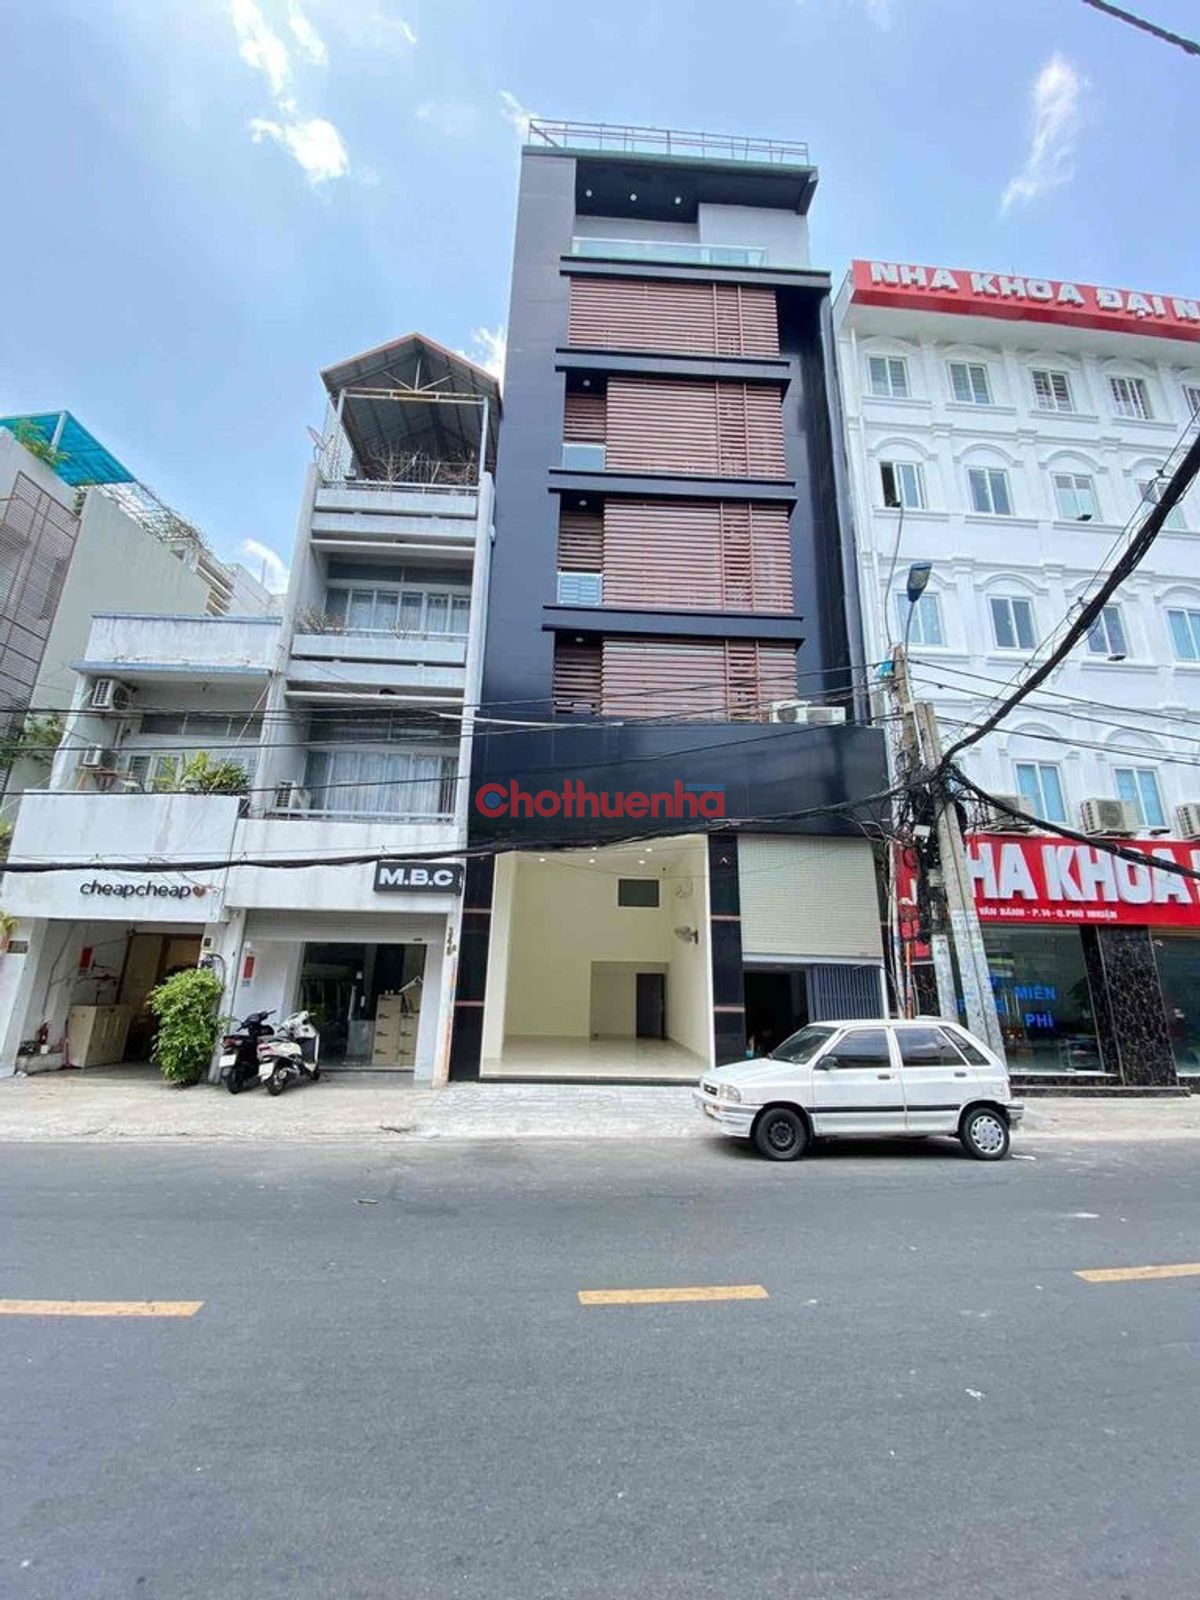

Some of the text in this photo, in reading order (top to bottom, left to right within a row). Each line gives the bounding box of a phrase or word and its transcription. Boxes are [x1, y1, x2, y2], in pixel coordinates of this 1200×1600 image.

[871, 261, 960, 291] NHA
[970, 272, 1084, 306] KHOA
[1096, 287, 1163, 317] ĐẠI
[80, 880, 191, 899] cheapcheap
[379, 867, 455, 886] M.B.C
[965, 842, 1037, 900] HA
[1042, 845, 1191, 905] KHOA
